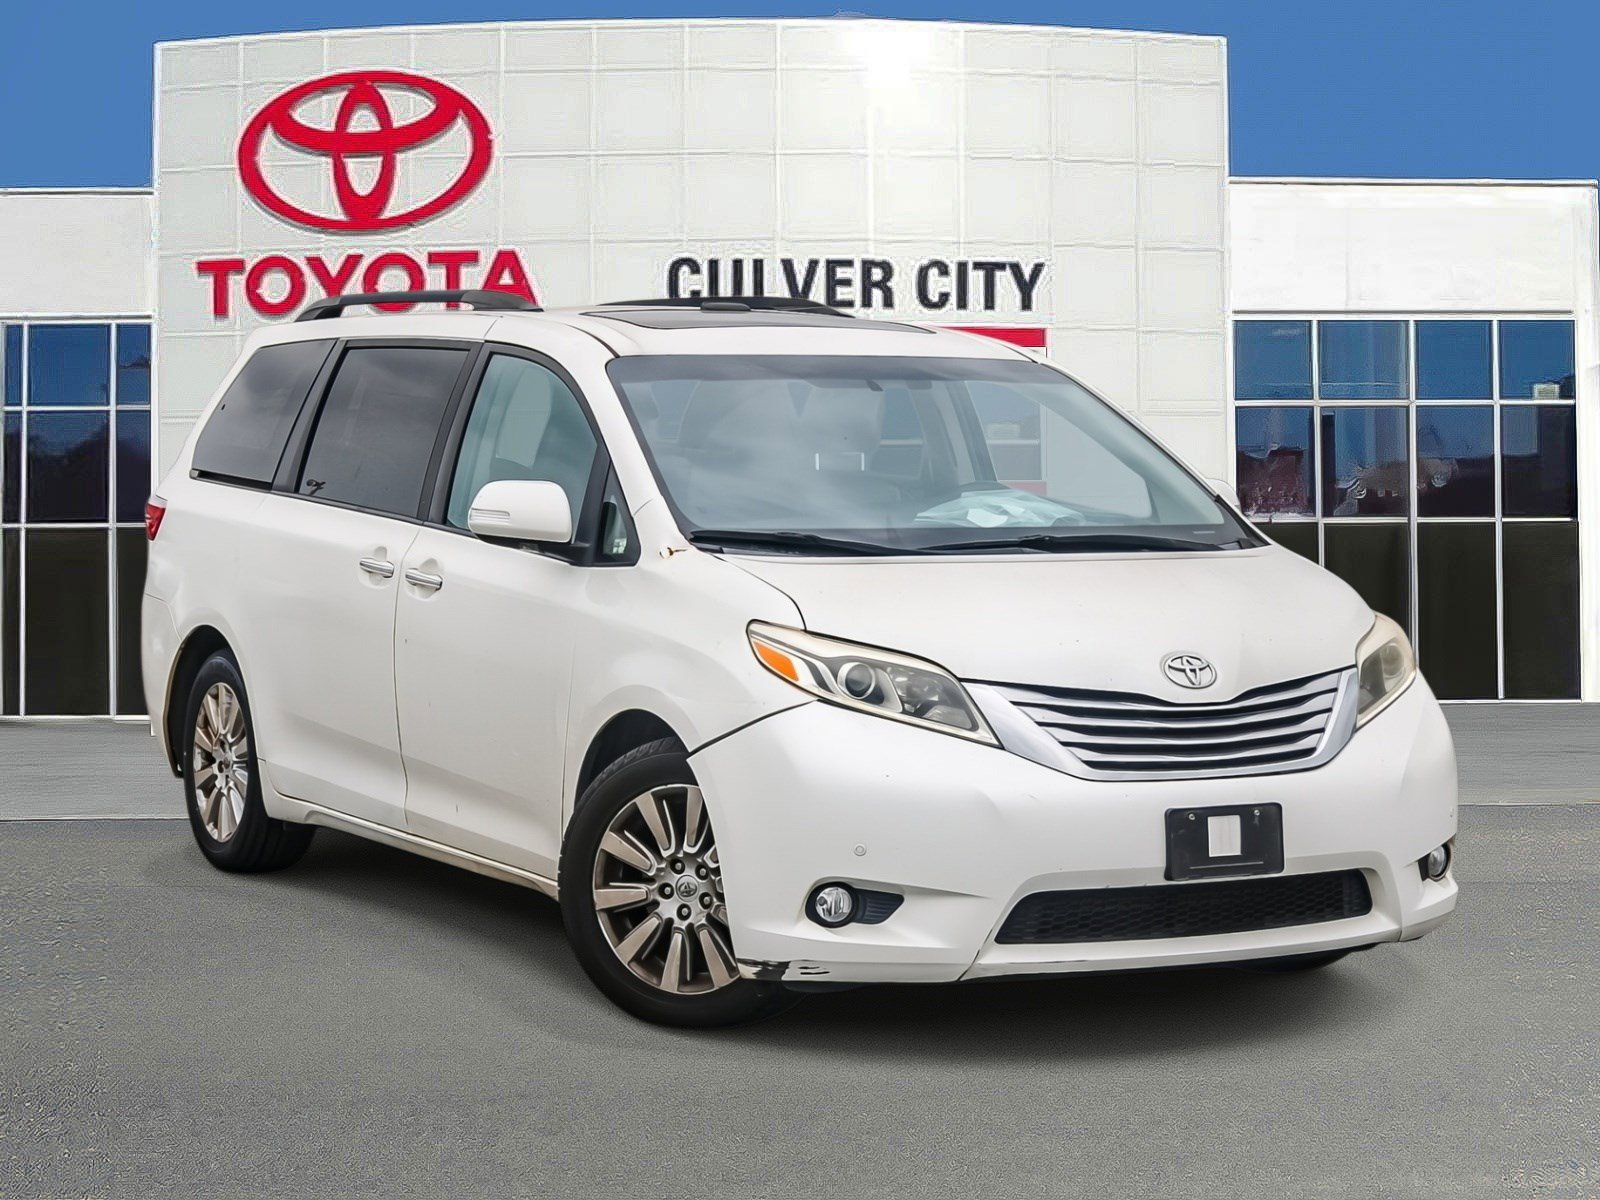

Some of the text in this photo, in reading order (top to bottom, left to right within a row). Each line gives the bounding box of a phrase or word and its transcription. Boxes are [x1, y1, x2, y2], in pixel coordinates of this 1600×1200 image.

[196, 249, 540, 317] TOYOTA
[667, 256, 1046, 311] CULVER CITY
